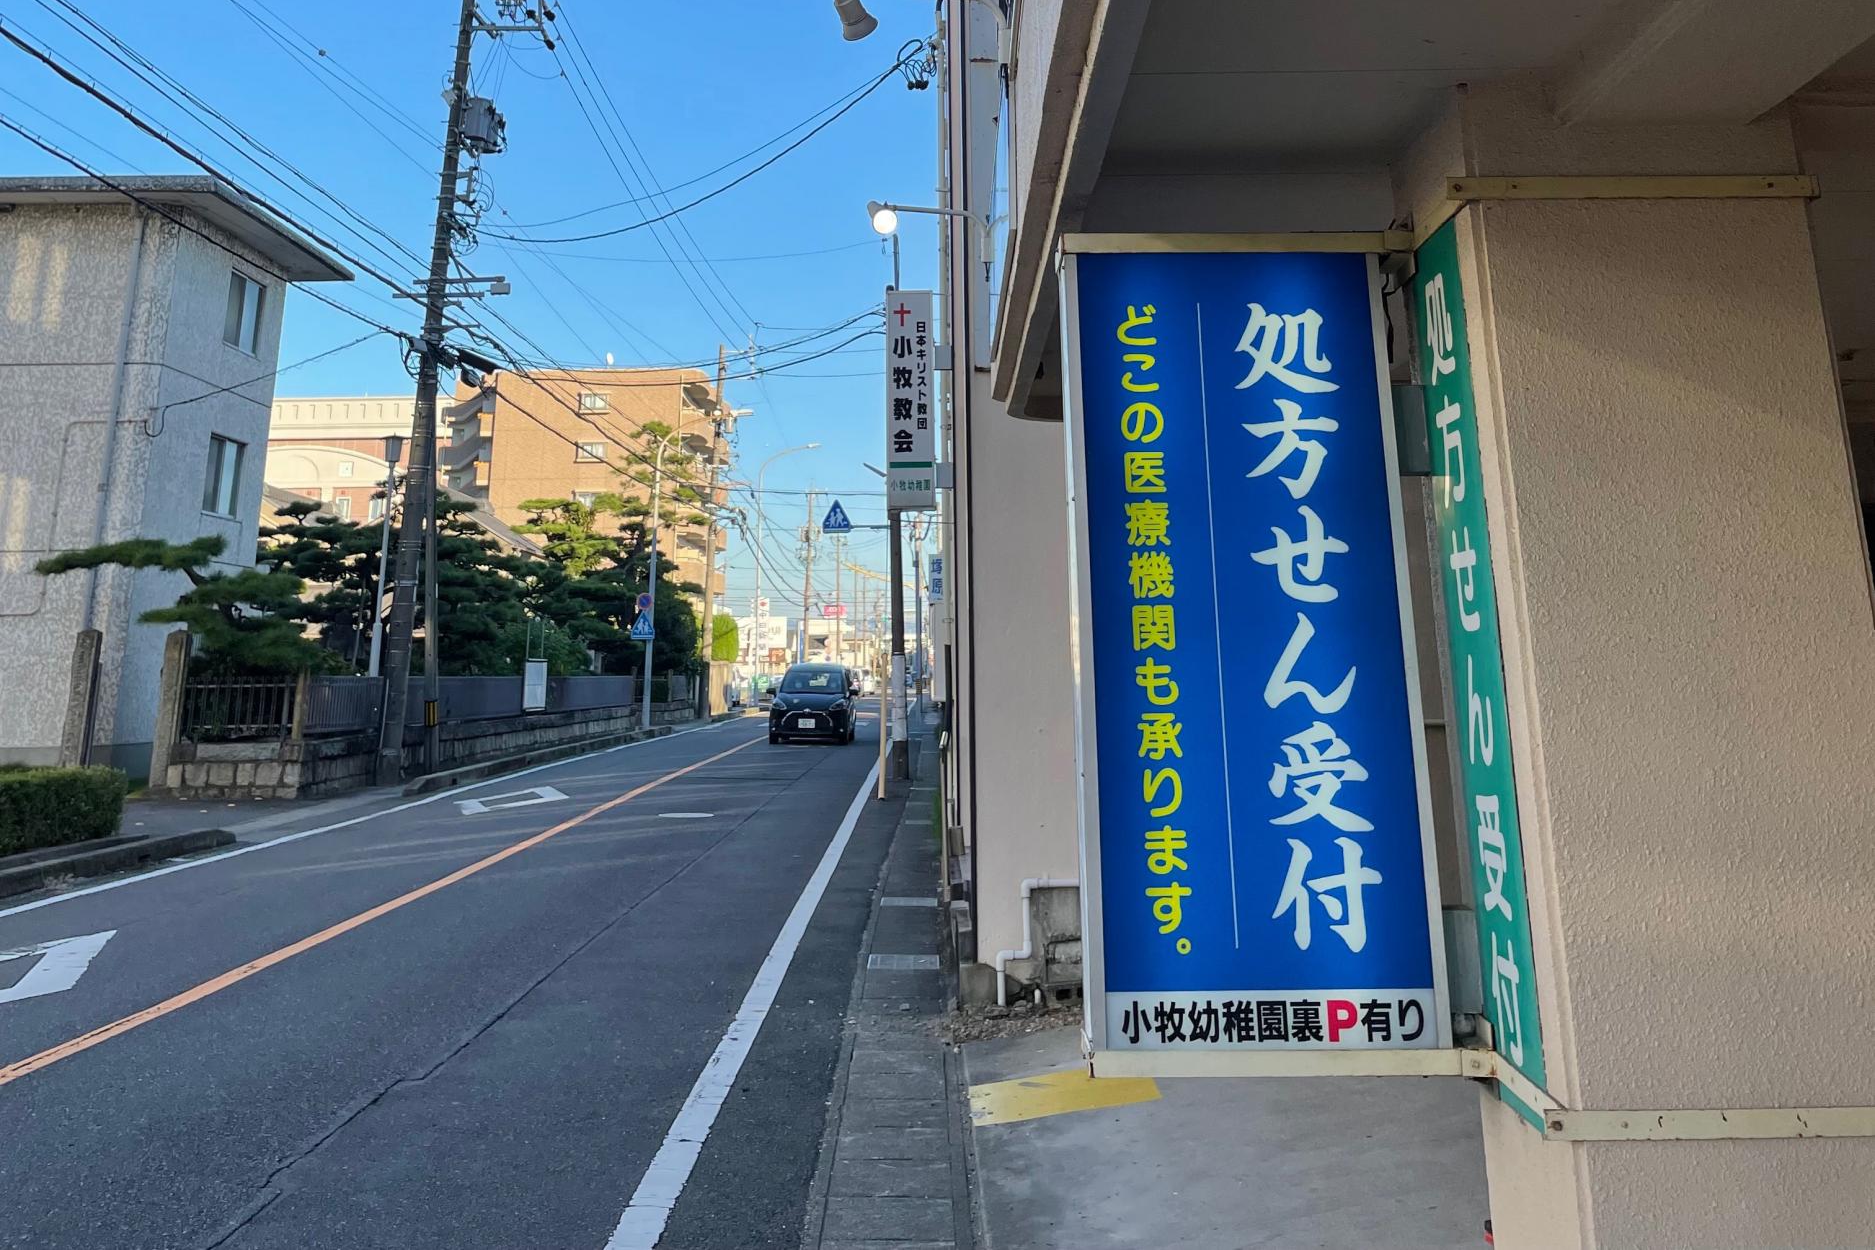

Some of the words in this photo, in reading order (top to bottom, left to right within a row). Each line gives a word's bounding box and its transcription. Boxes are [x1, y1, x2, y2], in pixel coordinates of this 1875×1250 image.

[893, 336, 913, 453] 小牧教会
[916, 321, 928, 430] 日本キリスト教団
[890, 479, 931, 492] 小牧幼稚園
[1116, 305, 1192, 955] どこの医療機関も承ります。
[1233, 302, 1383, 953] 処方せん受付
[1425, 272, 1523, 1067] 処方せん受付
[1121, 998, 1425, 1044] 小牧幼稚園裏P有り
